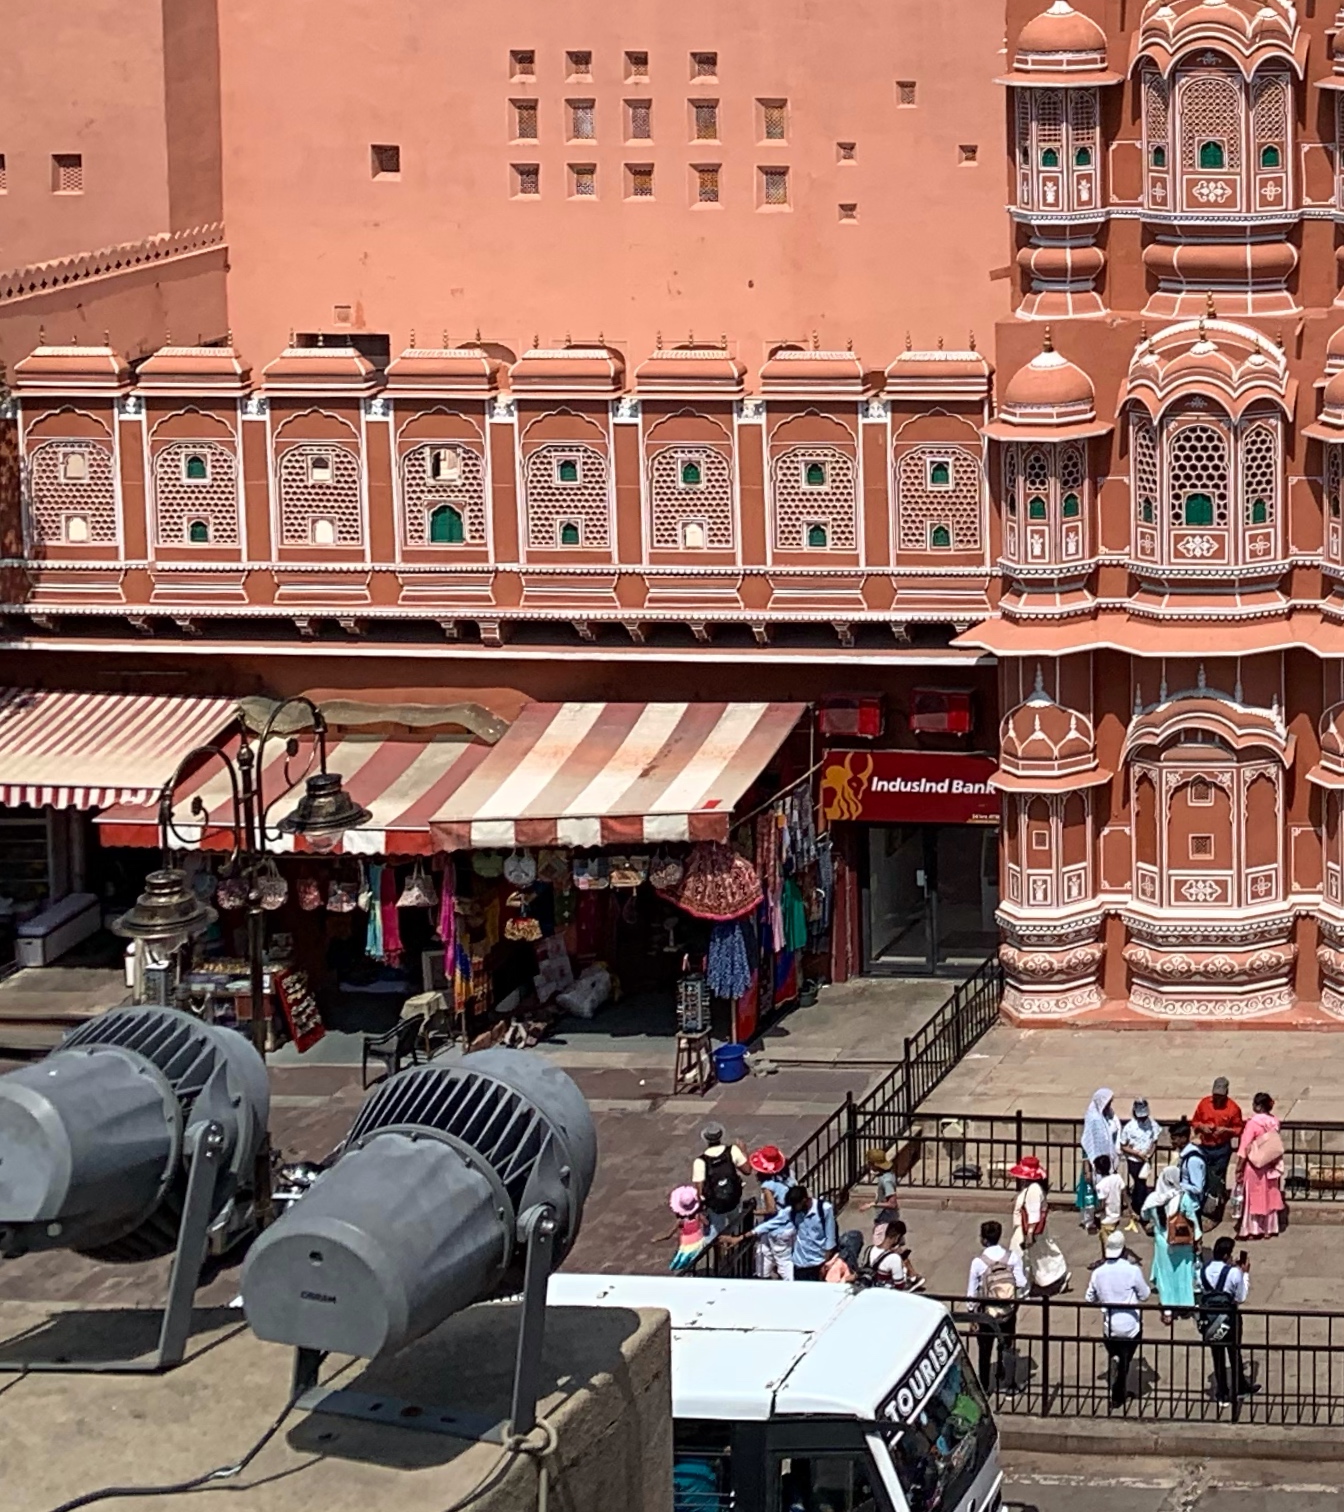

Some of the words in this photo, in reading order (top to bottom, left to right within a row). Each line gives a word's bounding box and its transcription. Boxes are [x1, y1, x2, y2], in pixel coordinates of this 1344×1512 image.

[871, 776, 949, 794] IndusInd
[951, 779, 996, 794] Bank
[884, 1325, 954, 1422] TOURIST
